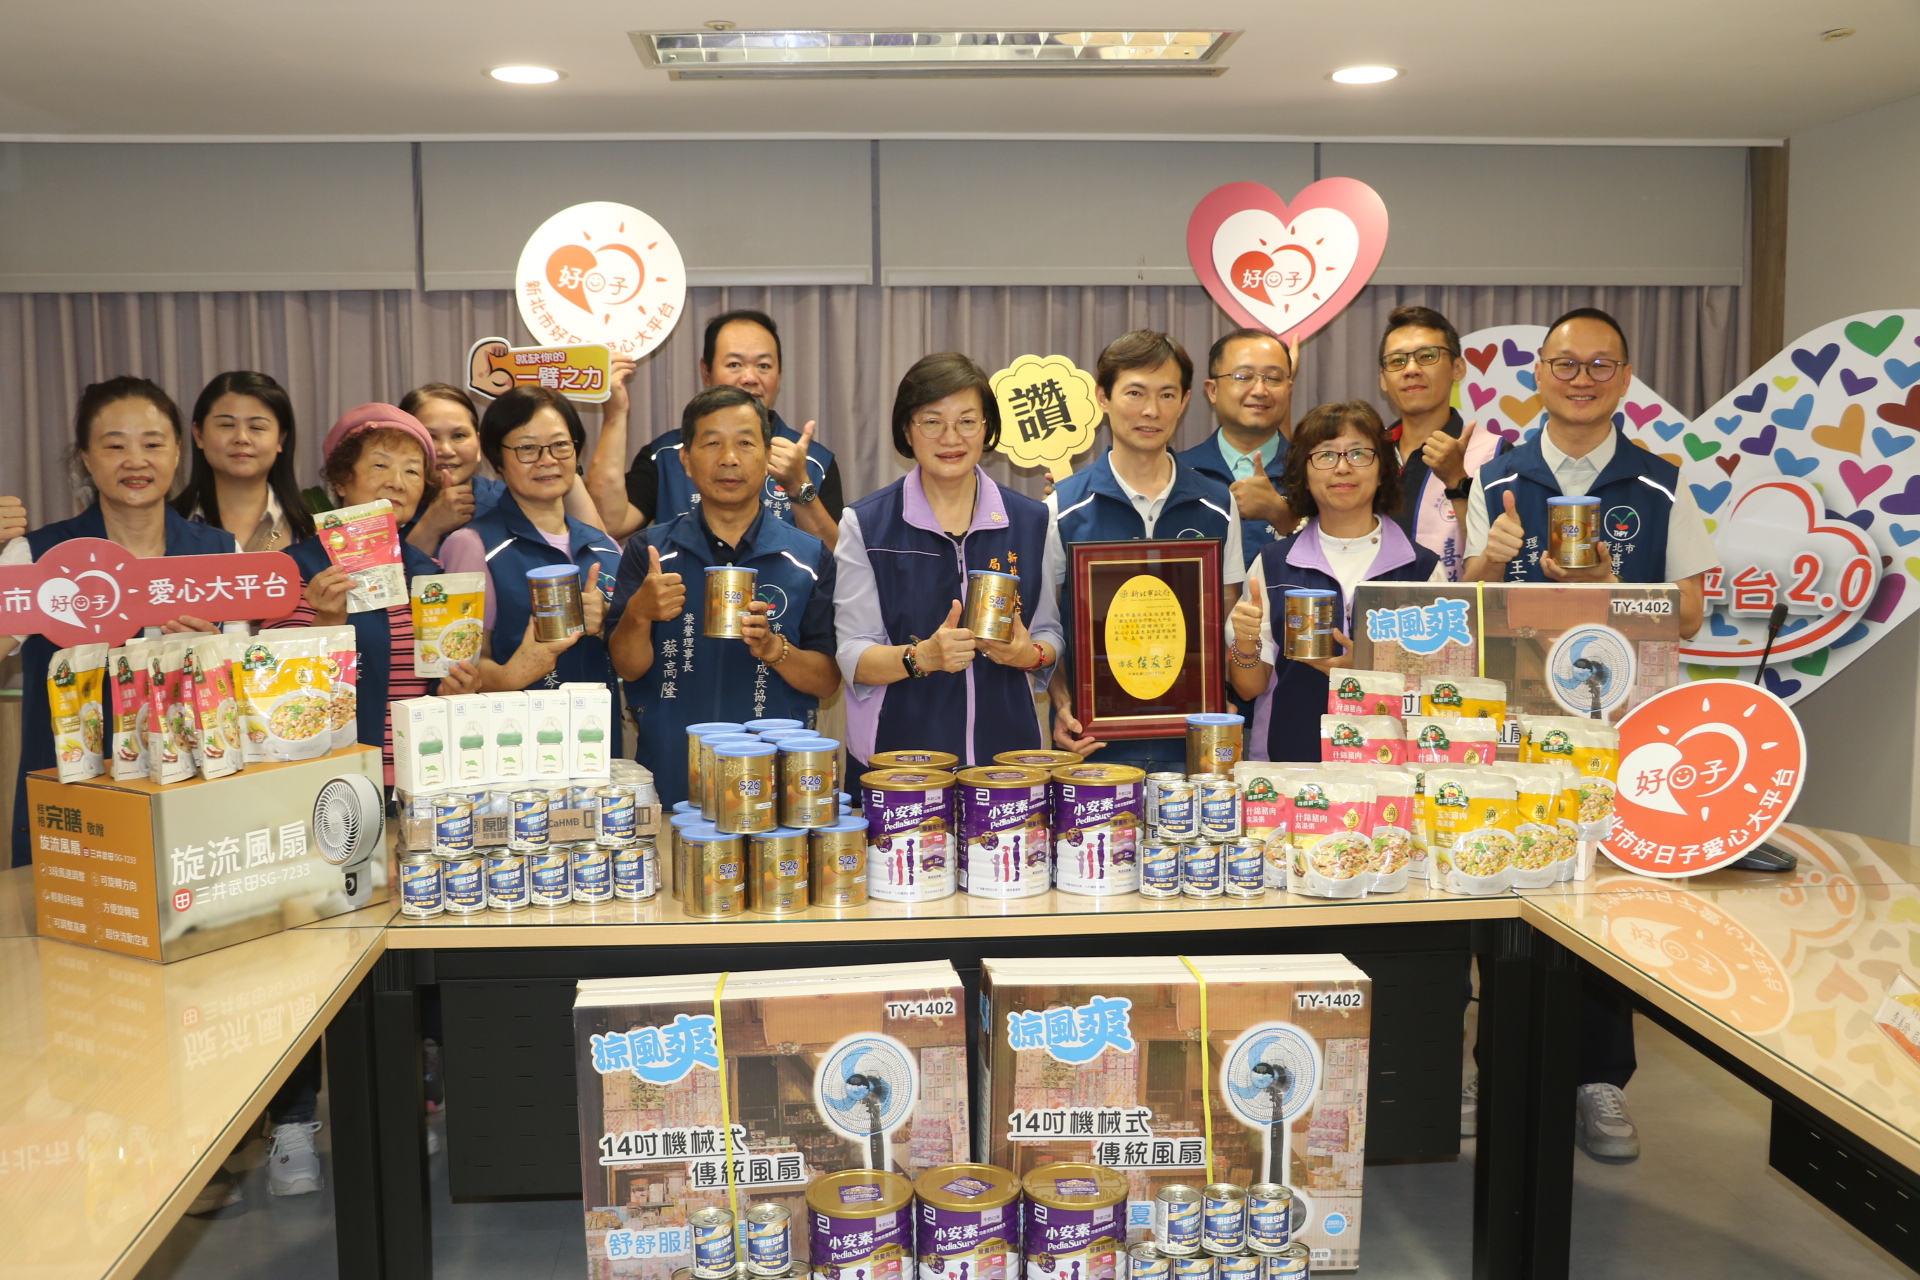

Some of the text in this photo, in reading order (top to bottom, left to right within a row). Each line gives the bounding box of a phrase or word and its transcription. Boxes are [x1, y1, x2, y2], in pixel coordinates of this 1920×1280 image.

[515, 351, 566, 364] 就缺你的
[516, 367, 602, 389] 一臂之力
[1008, 378, 1077, 442] 讚
[1526, 536, 1539, 565] 理事
[989, 558, 1000, 571] 局
[148, 572, 288, 605] 愛心大平台
[1131, 589, 1170, 597] 新北市政府
[1613, 601, 1669, 613] TY-1402
[682, 613, 695, 673] 榮譽理事長
[660, 640, 678, 699] 蔡高隆
[544, 670, 560, 689] 琴
[883, 803, 922, 823] 小安素
[988, 799, 1028, 819] 小安素
[1073, 797, 1114, 816] 小安素
[1246, 807, 1277, 815] 什錦豬肉
[1436, 810, 1467, 820] 玉米雞肉
[46, 805, 82, 833] 完膳
[87, 822, 104, 837] 敬贈
[548, 818, 579, 828] CaHMB
[1295, 813, 1328, 823] 什錦豬肉
[39, 835, 80, 856] 旋流風扇
[171, 819, 308, 887] 旋流風扇
[100, 875, 137, 892] 可旋轉方向
[103, 902, 139, 919] 方便旋轉鈕
[888, 1001, 954, 1018] TY-1402
[1297, 993, 1361, 1008] TY-1402
[1011, 1111, 1150, 1136] 14吋機械式
[602, 1128, 743, 1157] 14吋機械式
[1096, 1141, 1205, 1166] 傳統風扇
[692, 1157, 803, 1185] 傳統風扇
[1129, 1204, 1151, 1226] 夏
[829, 1231, 873, 1250] 小安素
[934, 1223, 979, 1241] 小安素
[1045, 1223, 1090, 1240] 小安素
[831, 1246, 873, 1261] PediaSure
[936, 1238, 978, 1252] PediaSure
[1047, 1237, 1090, 1251] PediaSure
